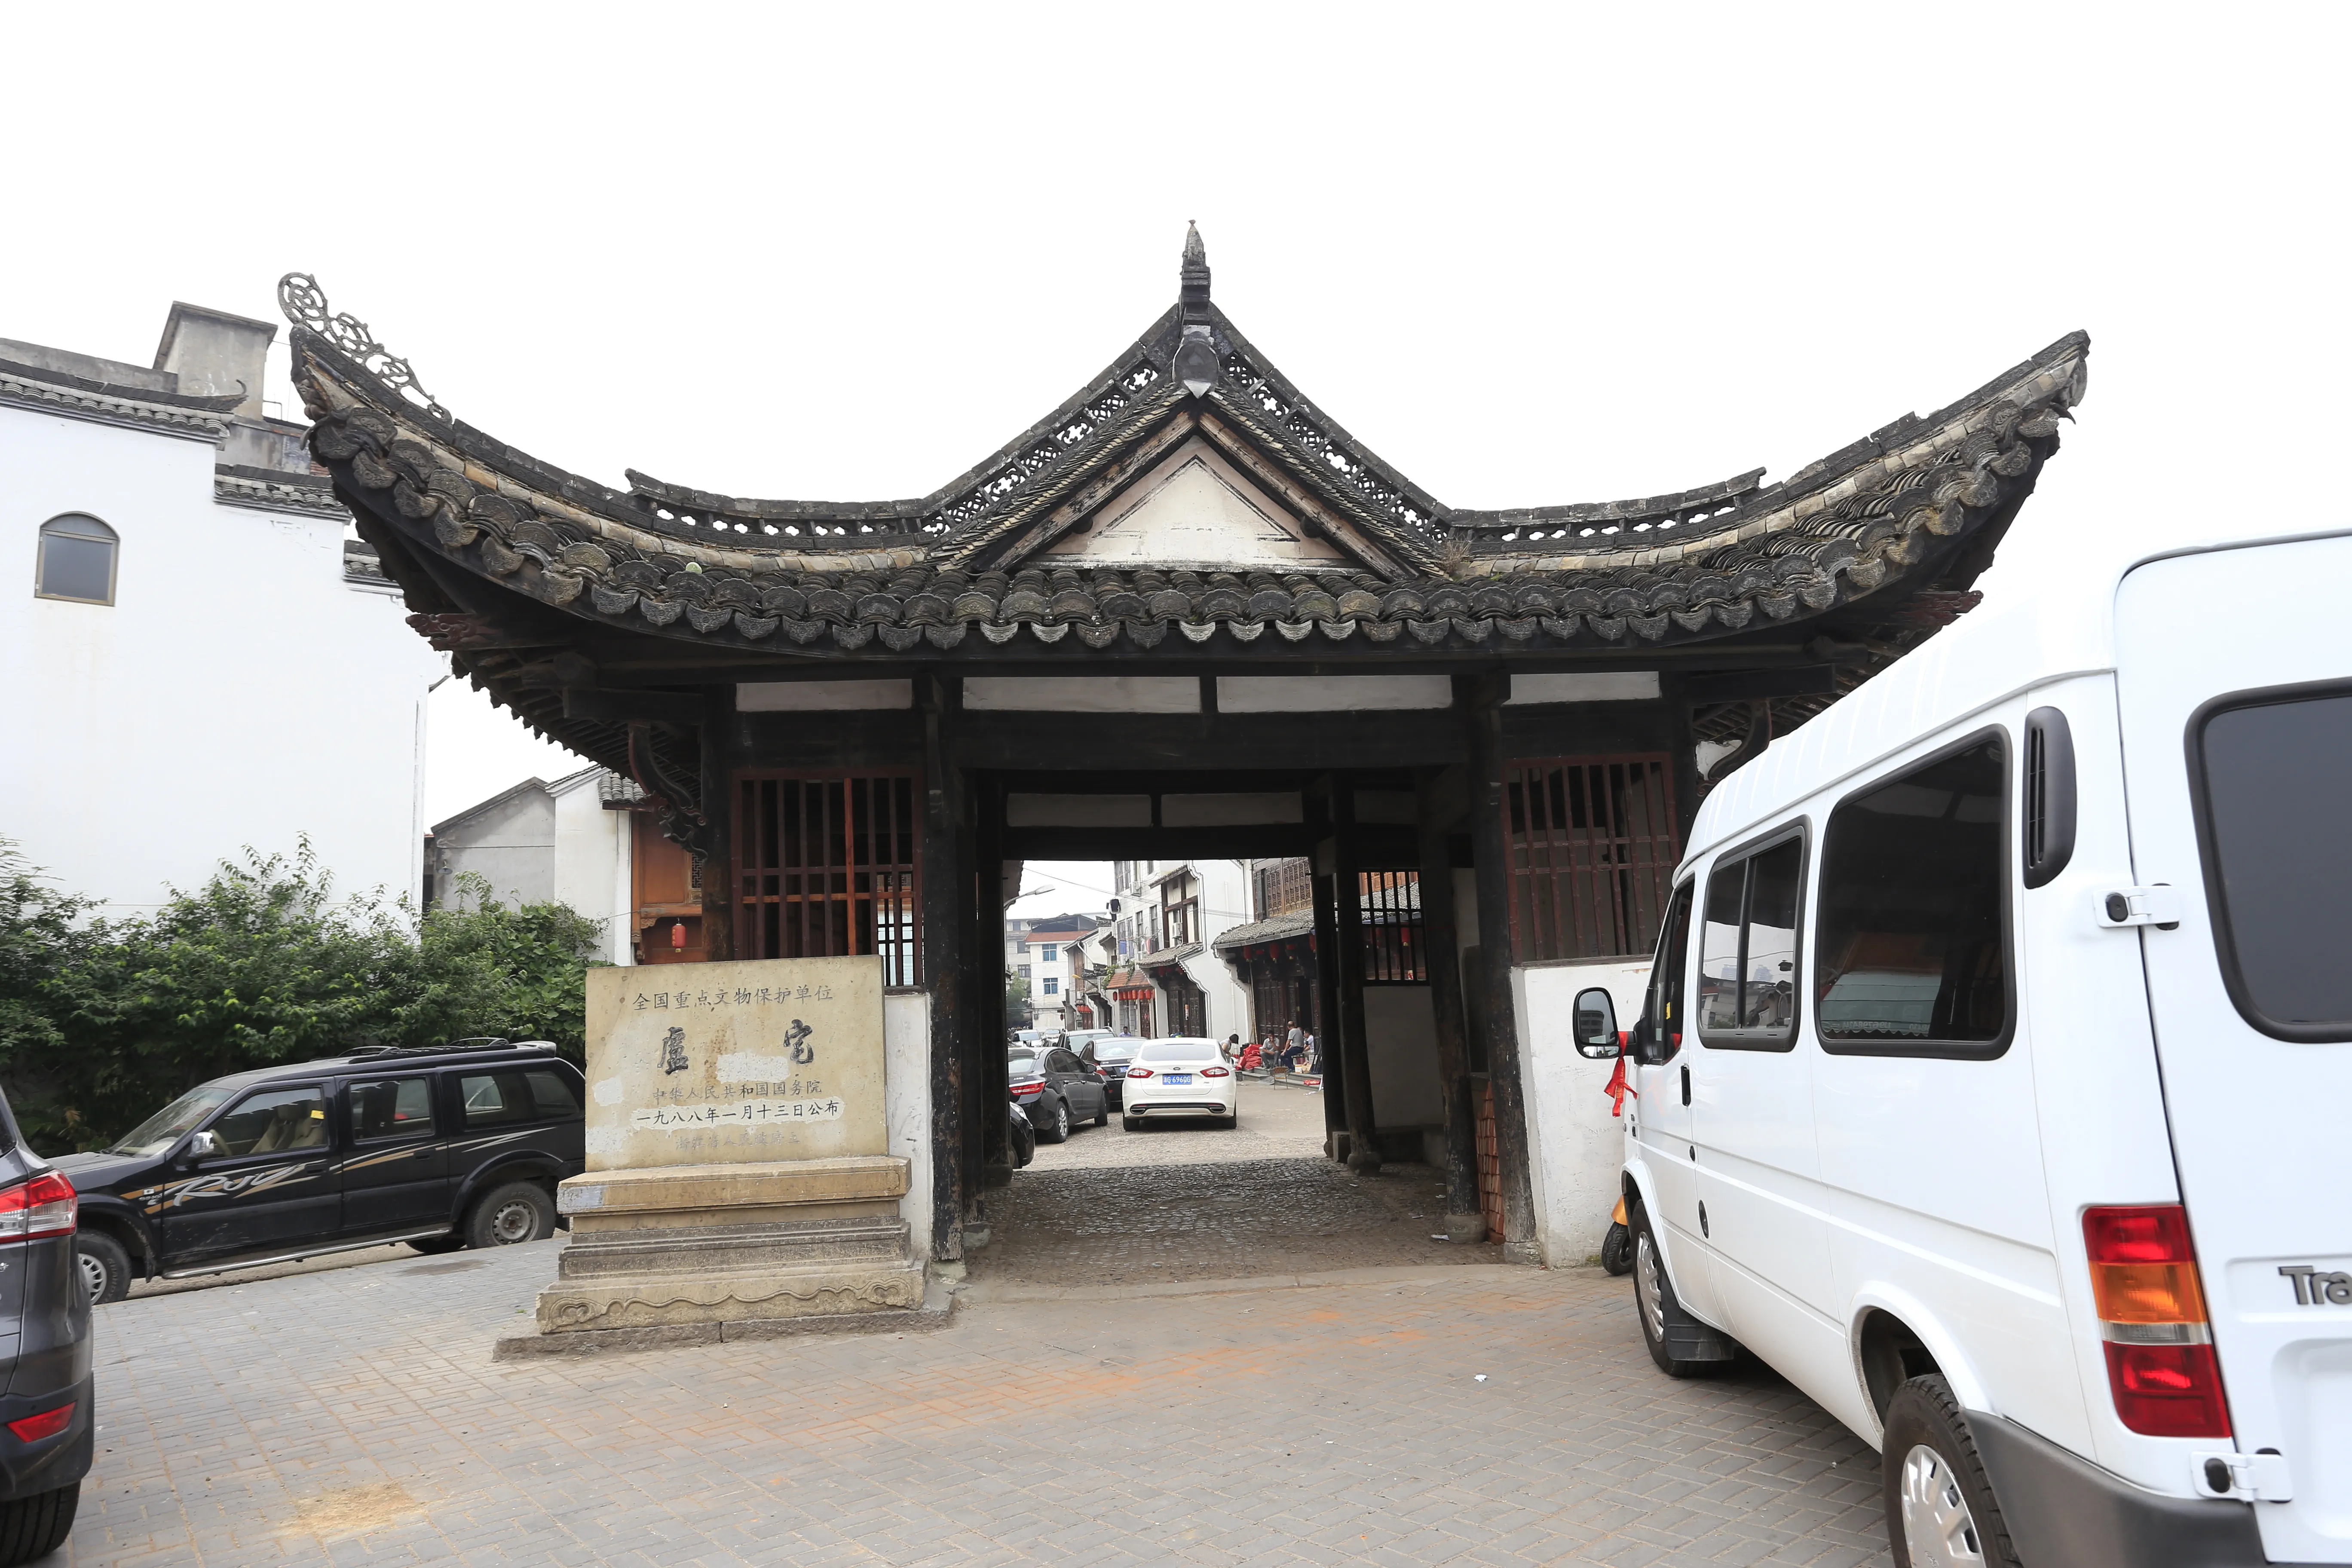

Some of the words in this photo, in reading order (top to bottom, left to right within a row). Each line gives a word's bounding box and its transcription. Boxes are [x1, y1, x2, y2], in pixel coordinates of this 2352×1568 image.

[632, 985, 833, 1011] 全国重点文物保护单位
[652, 1080, 822, 1105] 中华人民共和国国务院
[636, 1100, 840, 1124] 一九八八年一月十三日公布
[676, 1130, 800, 1151] 浙江省人民政府立
